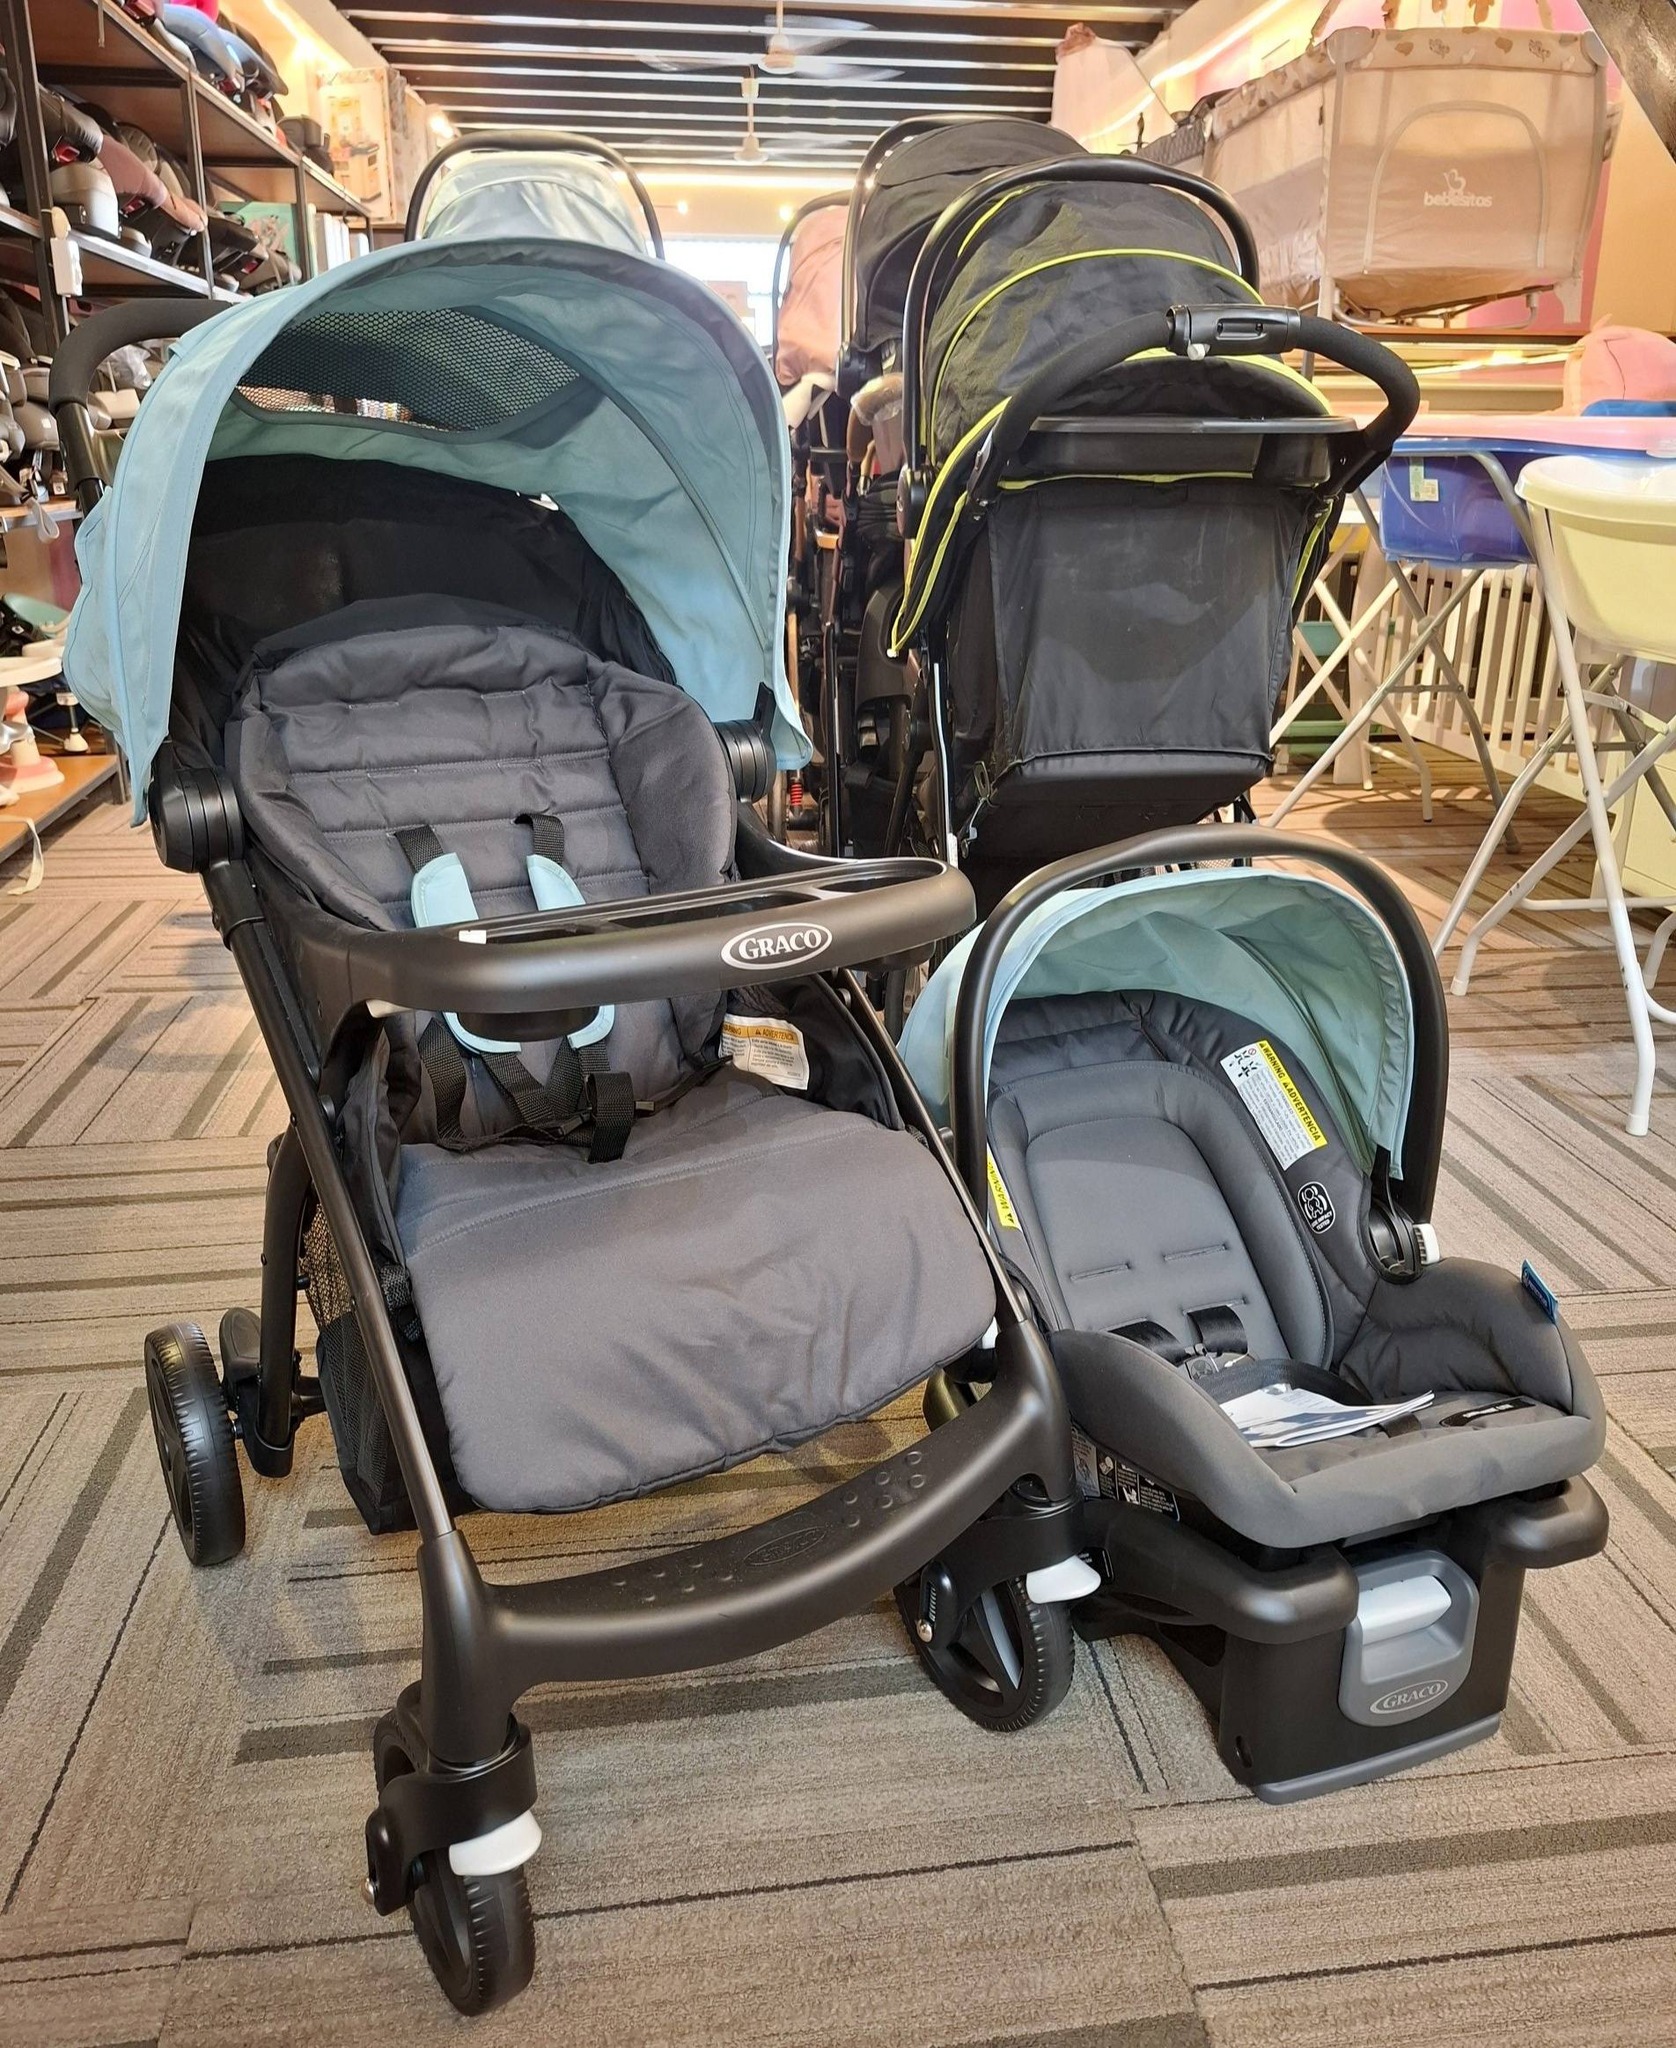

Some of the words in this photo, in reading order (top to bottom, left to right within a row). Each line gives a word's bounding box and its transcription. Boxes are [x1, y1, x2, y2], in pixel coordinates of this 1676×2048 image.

[1423, 190, 1493, 208] bebesitos
[738, 929, 822, 960] GRACO
[1262, 1047, 1286, 1079] WARNING
[1287, 1087, 1322, 1142] ADVERTENCIA
[1383, 1682, 1442, 1709] GRACO
